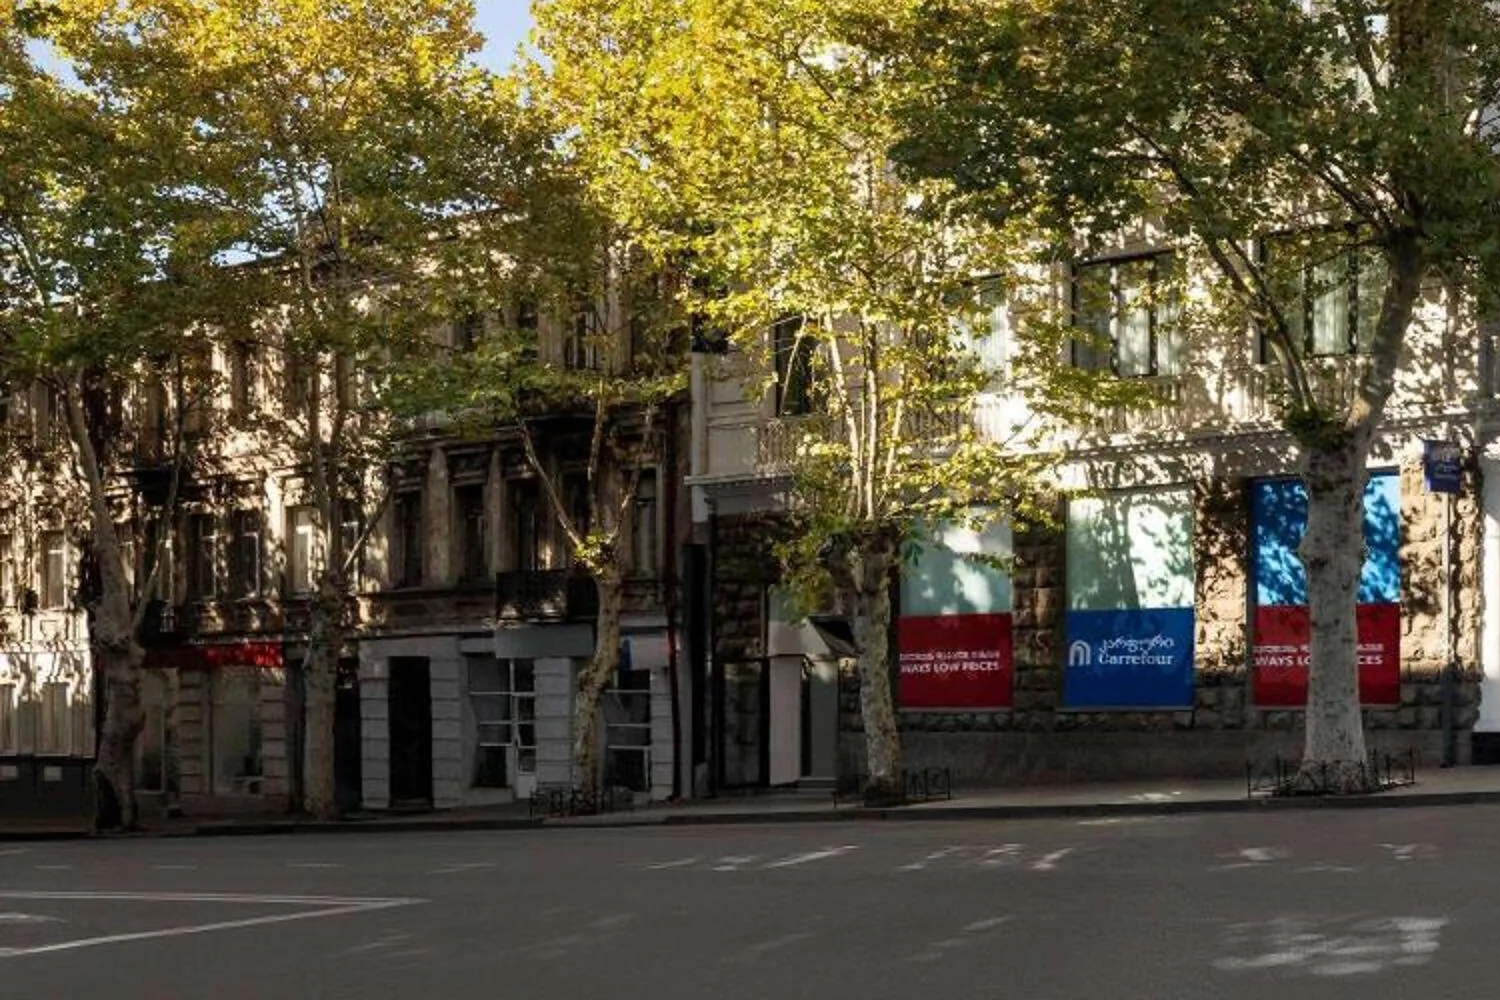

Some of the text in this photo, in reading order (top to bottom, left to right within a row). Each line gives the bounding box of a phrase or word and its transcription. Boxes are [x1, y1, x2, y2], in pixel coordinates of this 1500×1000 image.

[1099, 652, 1173, 665] Carrefour
[1255, 655, 1294, 666] WAYS
[1297, 655, 1312, 665] LO
[901, 663, 931, 674] WAYS
[933, 662, 960, 674] LOW
